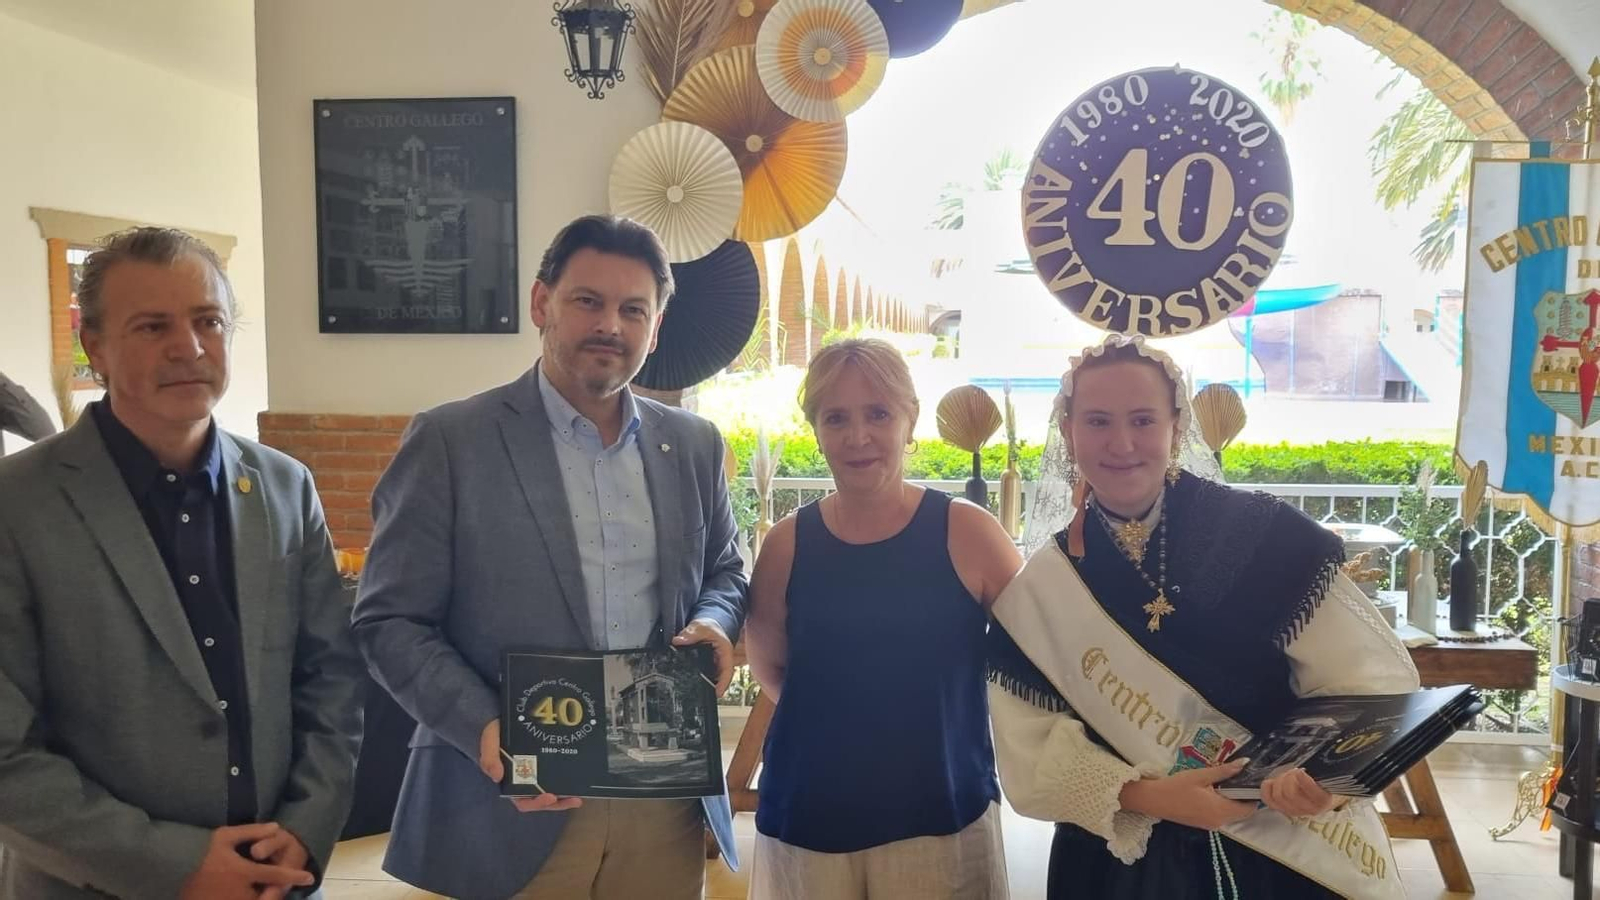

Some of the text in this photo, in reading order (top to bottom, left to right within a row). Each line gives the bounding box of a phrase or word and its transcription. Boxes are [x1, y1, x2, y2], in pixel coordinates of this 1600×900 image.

[344, 112, 483, 128] CENTRO GALLEGO
[1060, 74, 1270, 148] 1980 2020
[1086, 148, 1235, 251] 40
[1025, 157, 1293, 337] ANIVERSARIO
[1480, 215, 1587, 273] CENTRO
[377, 307, 397, 320] DE
[532, 695, 584, 727] 40
[1081, 647, 1181, 748] Centro
[522, 722, 593, 745] ANIVERSARIO
[1287, 815, 1387, 880] allego
